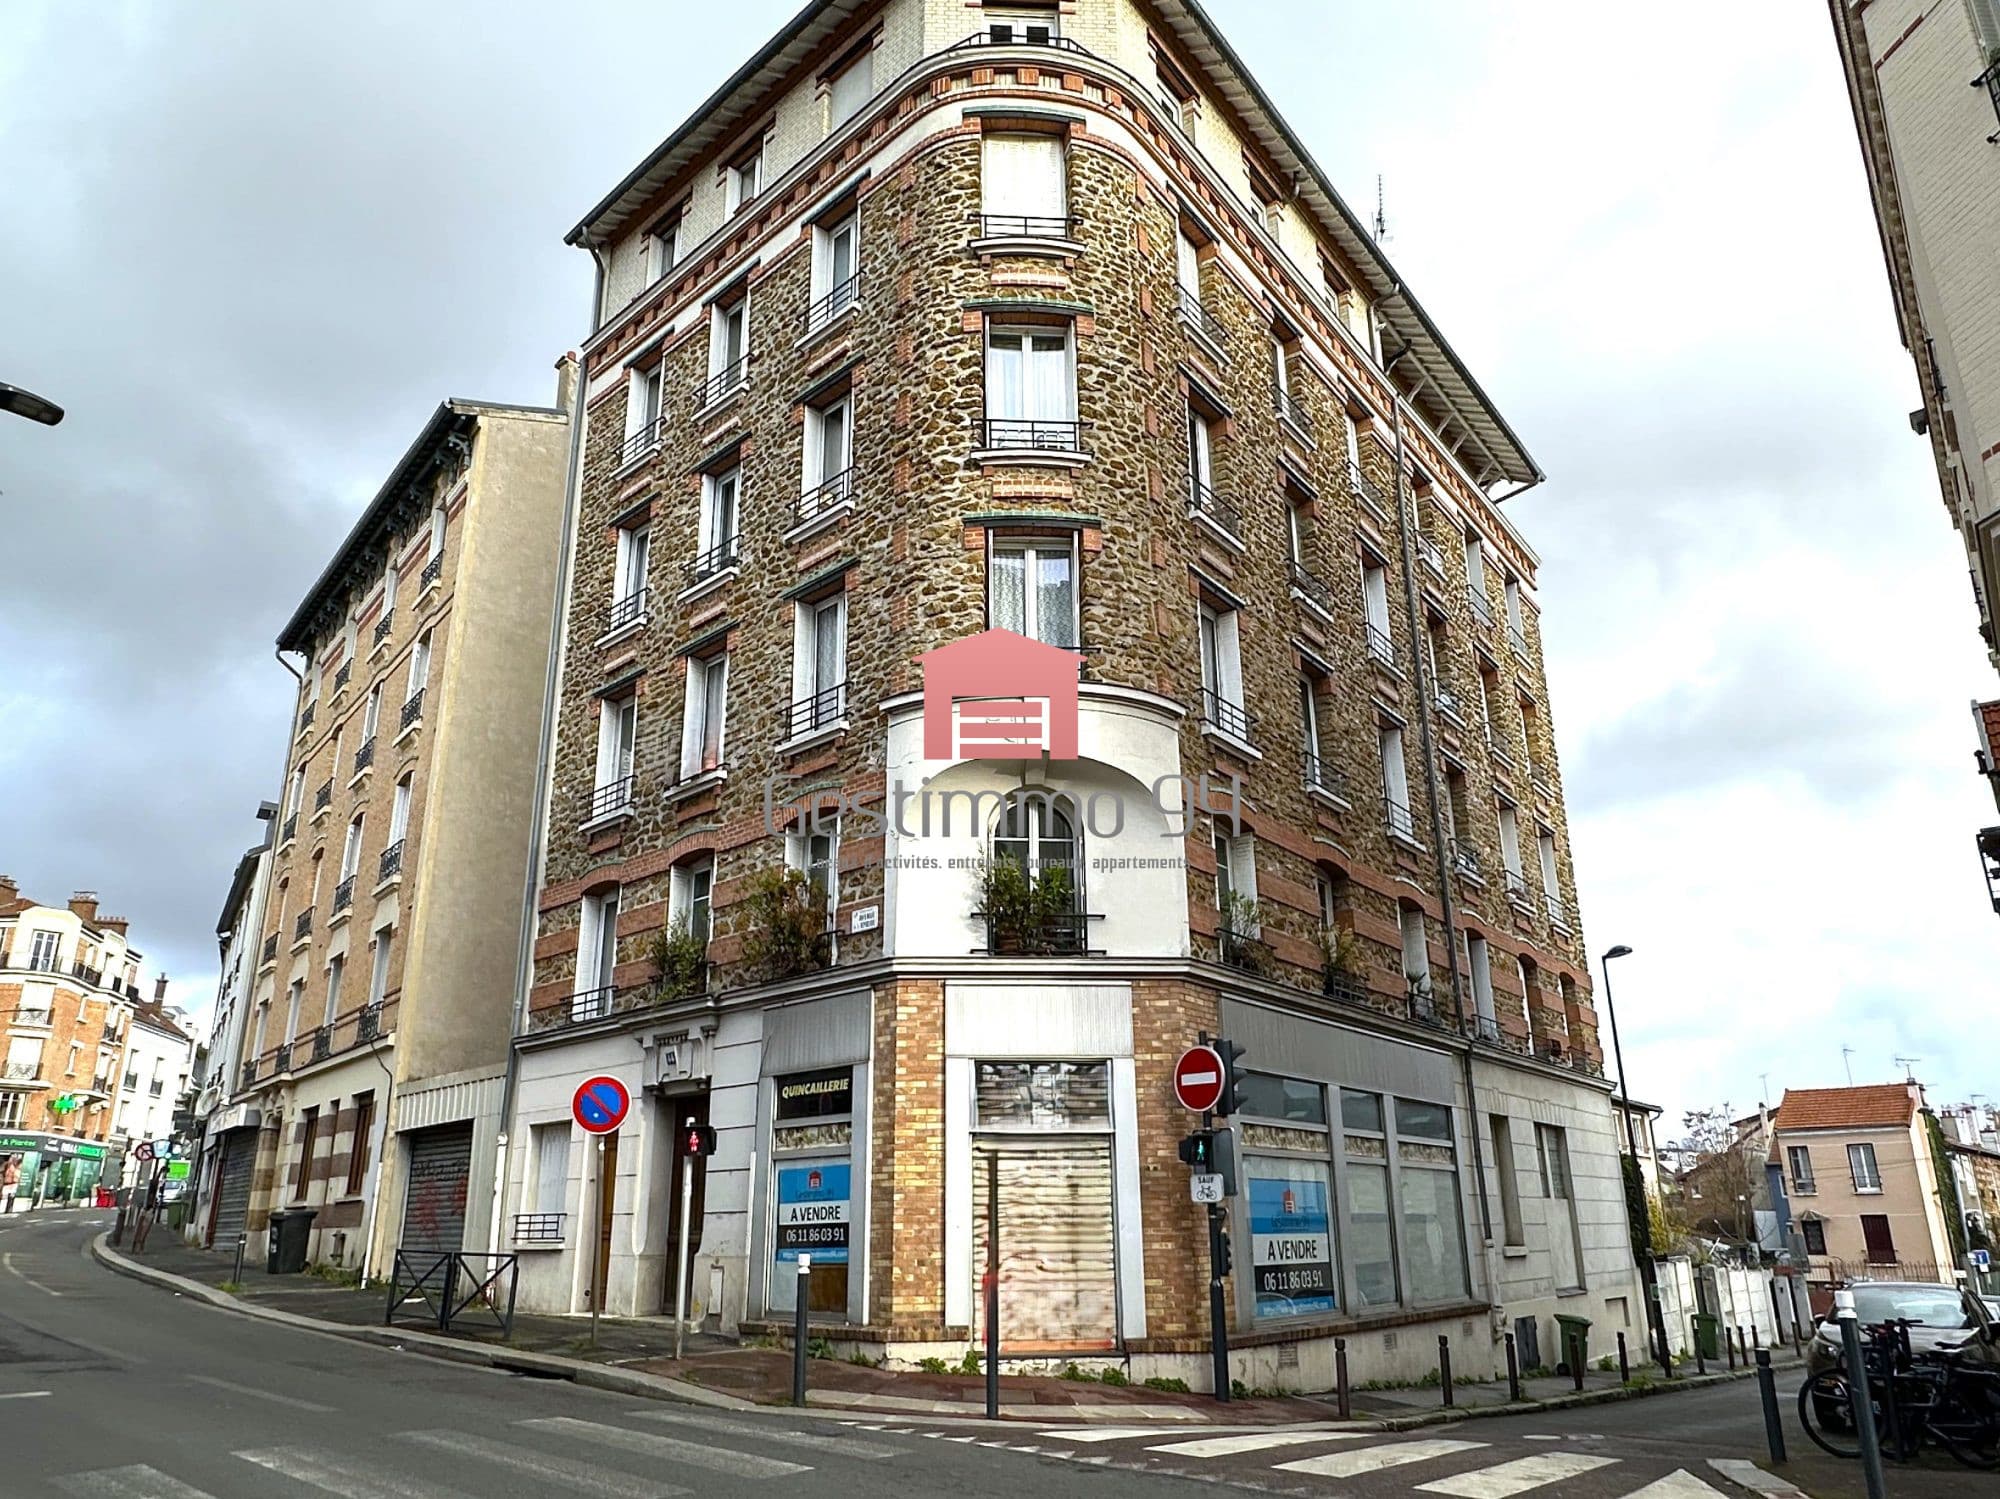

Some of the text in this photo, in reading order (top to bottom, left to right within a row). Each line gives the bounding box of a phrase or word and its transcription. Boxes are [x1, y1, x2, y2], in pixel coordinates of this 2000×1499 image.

[782, 1078, 849, 1099] QUINCAILLERIE
[791, 1206, 841, 1222] A VENDRE
[786, 1227, 845, 1242] 06 11 86 03 91
[1268, 1240, 1317, 1260] A VENDRE
[1264, 1270, 1323, 1291] 06 11 86 03 91
